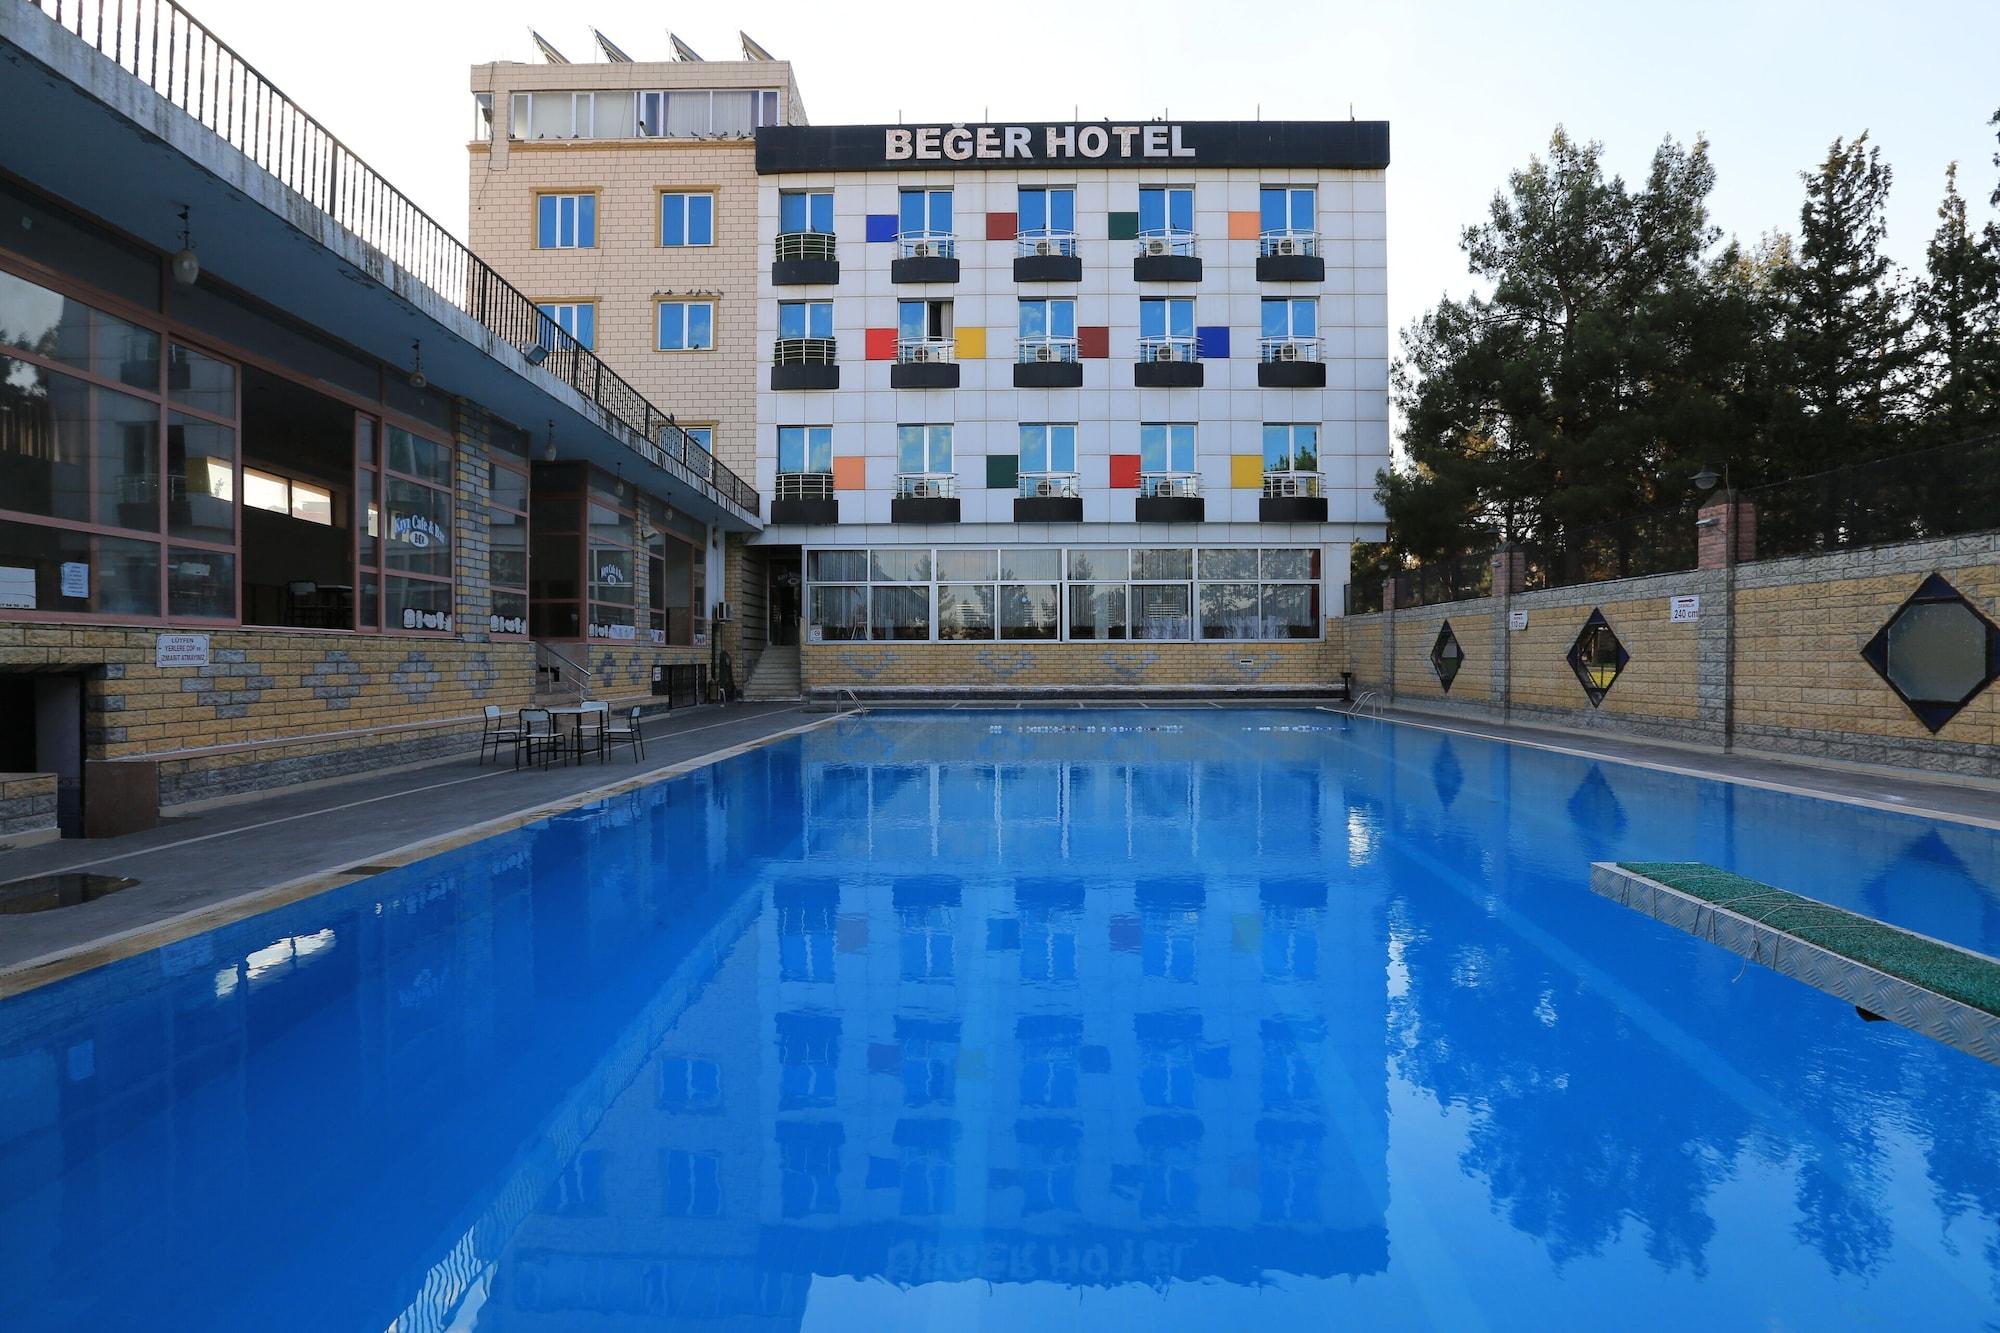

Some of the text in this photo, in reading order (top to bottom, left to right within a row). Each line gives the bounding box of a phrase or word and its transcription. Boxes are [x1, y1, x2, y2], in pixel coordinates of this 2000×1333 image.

[886, 122, 1196, 161] BEĞER HOTEL
[411, 514, 428, 532] Cafe
[1674, 609, 1698, 619] 240 cm
